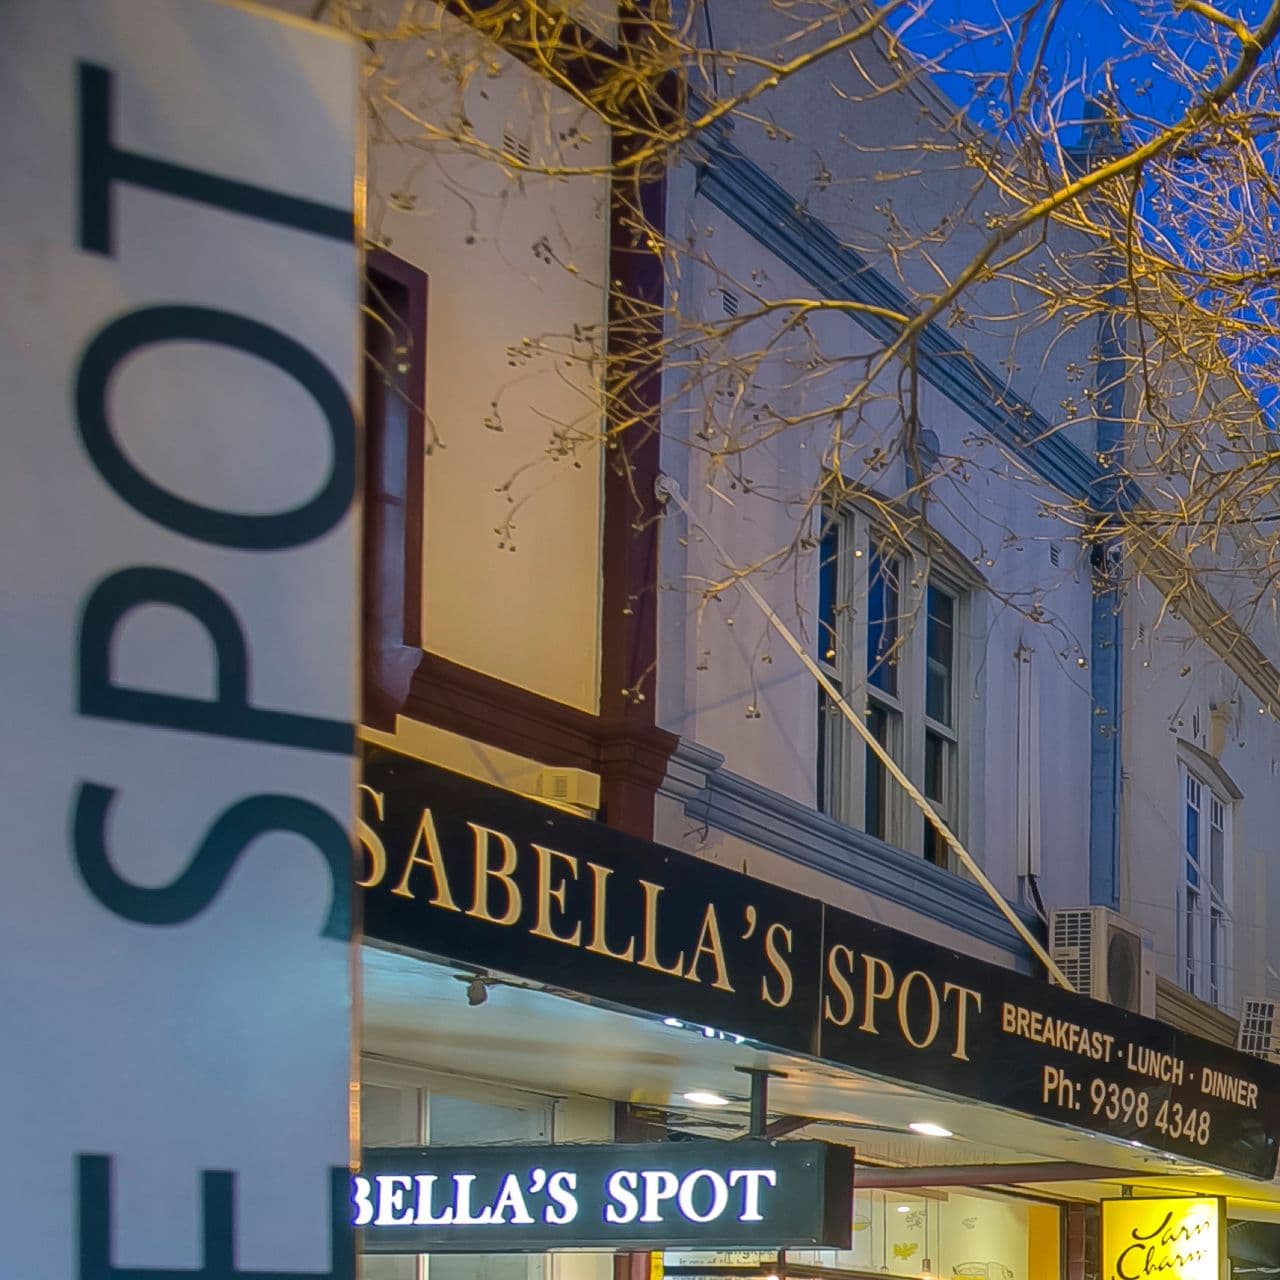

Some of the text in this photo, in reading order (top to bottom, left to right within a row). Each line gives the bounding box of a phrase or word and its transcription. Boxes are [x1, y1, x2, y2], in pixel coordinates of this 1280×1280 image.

[71, 61, 359, 942] SPOT
[825, 944, 981, 1061] SPOT
[1002, 1002, 1259, 1110] BREAKFAST LUNCH DINNER
[1042, 1064, 1211, 1145] Ph: 9398 4348
[604, 1168, 777, 1223] SPOT
